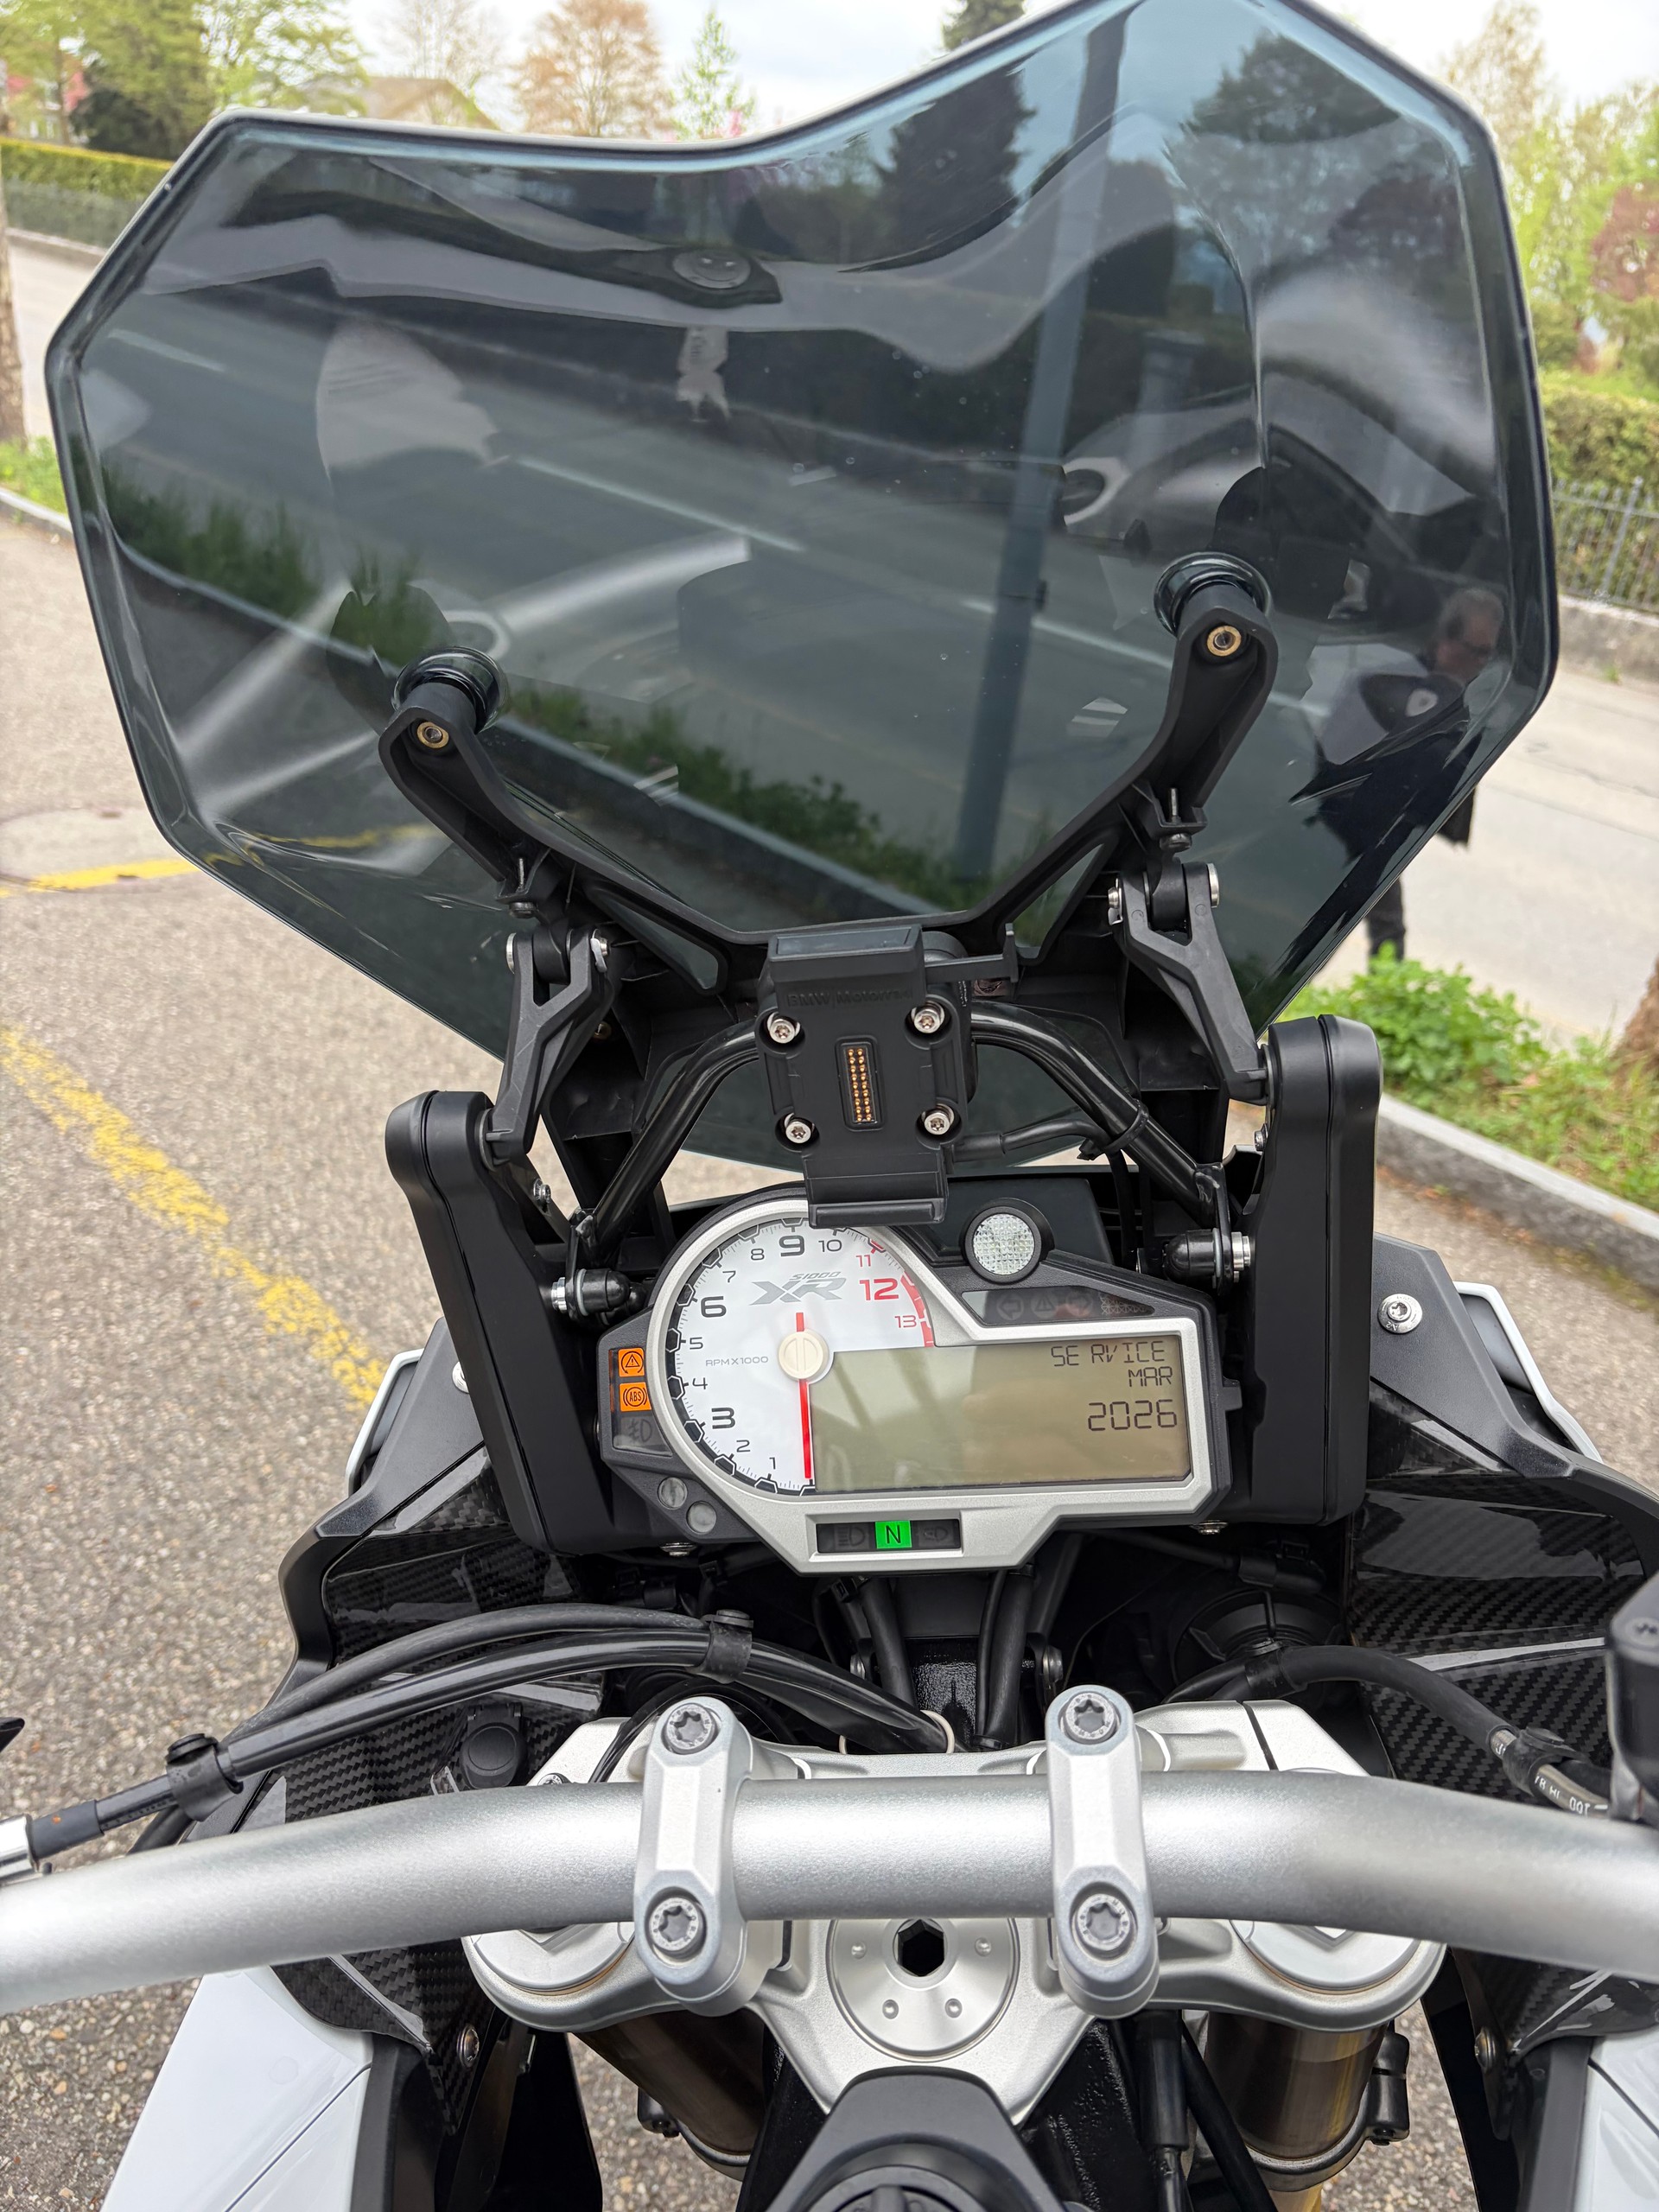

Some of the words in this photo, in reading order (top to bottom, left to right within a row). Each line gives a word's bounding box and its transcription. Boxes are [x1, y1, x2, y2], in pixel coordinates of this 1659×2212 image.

[787, 992, 830, 1007] BMW
[779, 1235, 805, 1257] 9
[818, 1239, 842, 1253] 10
[750, 1248, 765, 1261] 8
[855, 1254, 872, 1268] 11
[722, 1270, 736, 1283] 7
[789, 1271, 842, 1281] S1000
[749, 1278, 847, 1306] XR
[859, 1277, 899, 1301] 12
[700, 1295, 727, 1318] 6
[894, 1314, 918, 1329] 13
[689, 1336, 704, 1350] 5
[692, 1377, 709, 1390] 4
[1128, 1366, 1173, 1388] MAR
[629, 1390, 642, 1402] ABS
[711, 1407, 736, 1430] 3
[1088, 1399, 1178, 1432] 2026
[735, 1440, 751, 1452] 2
[769, 1457, 777, 1470] 1
[885, 1524, 901, 1544] N
